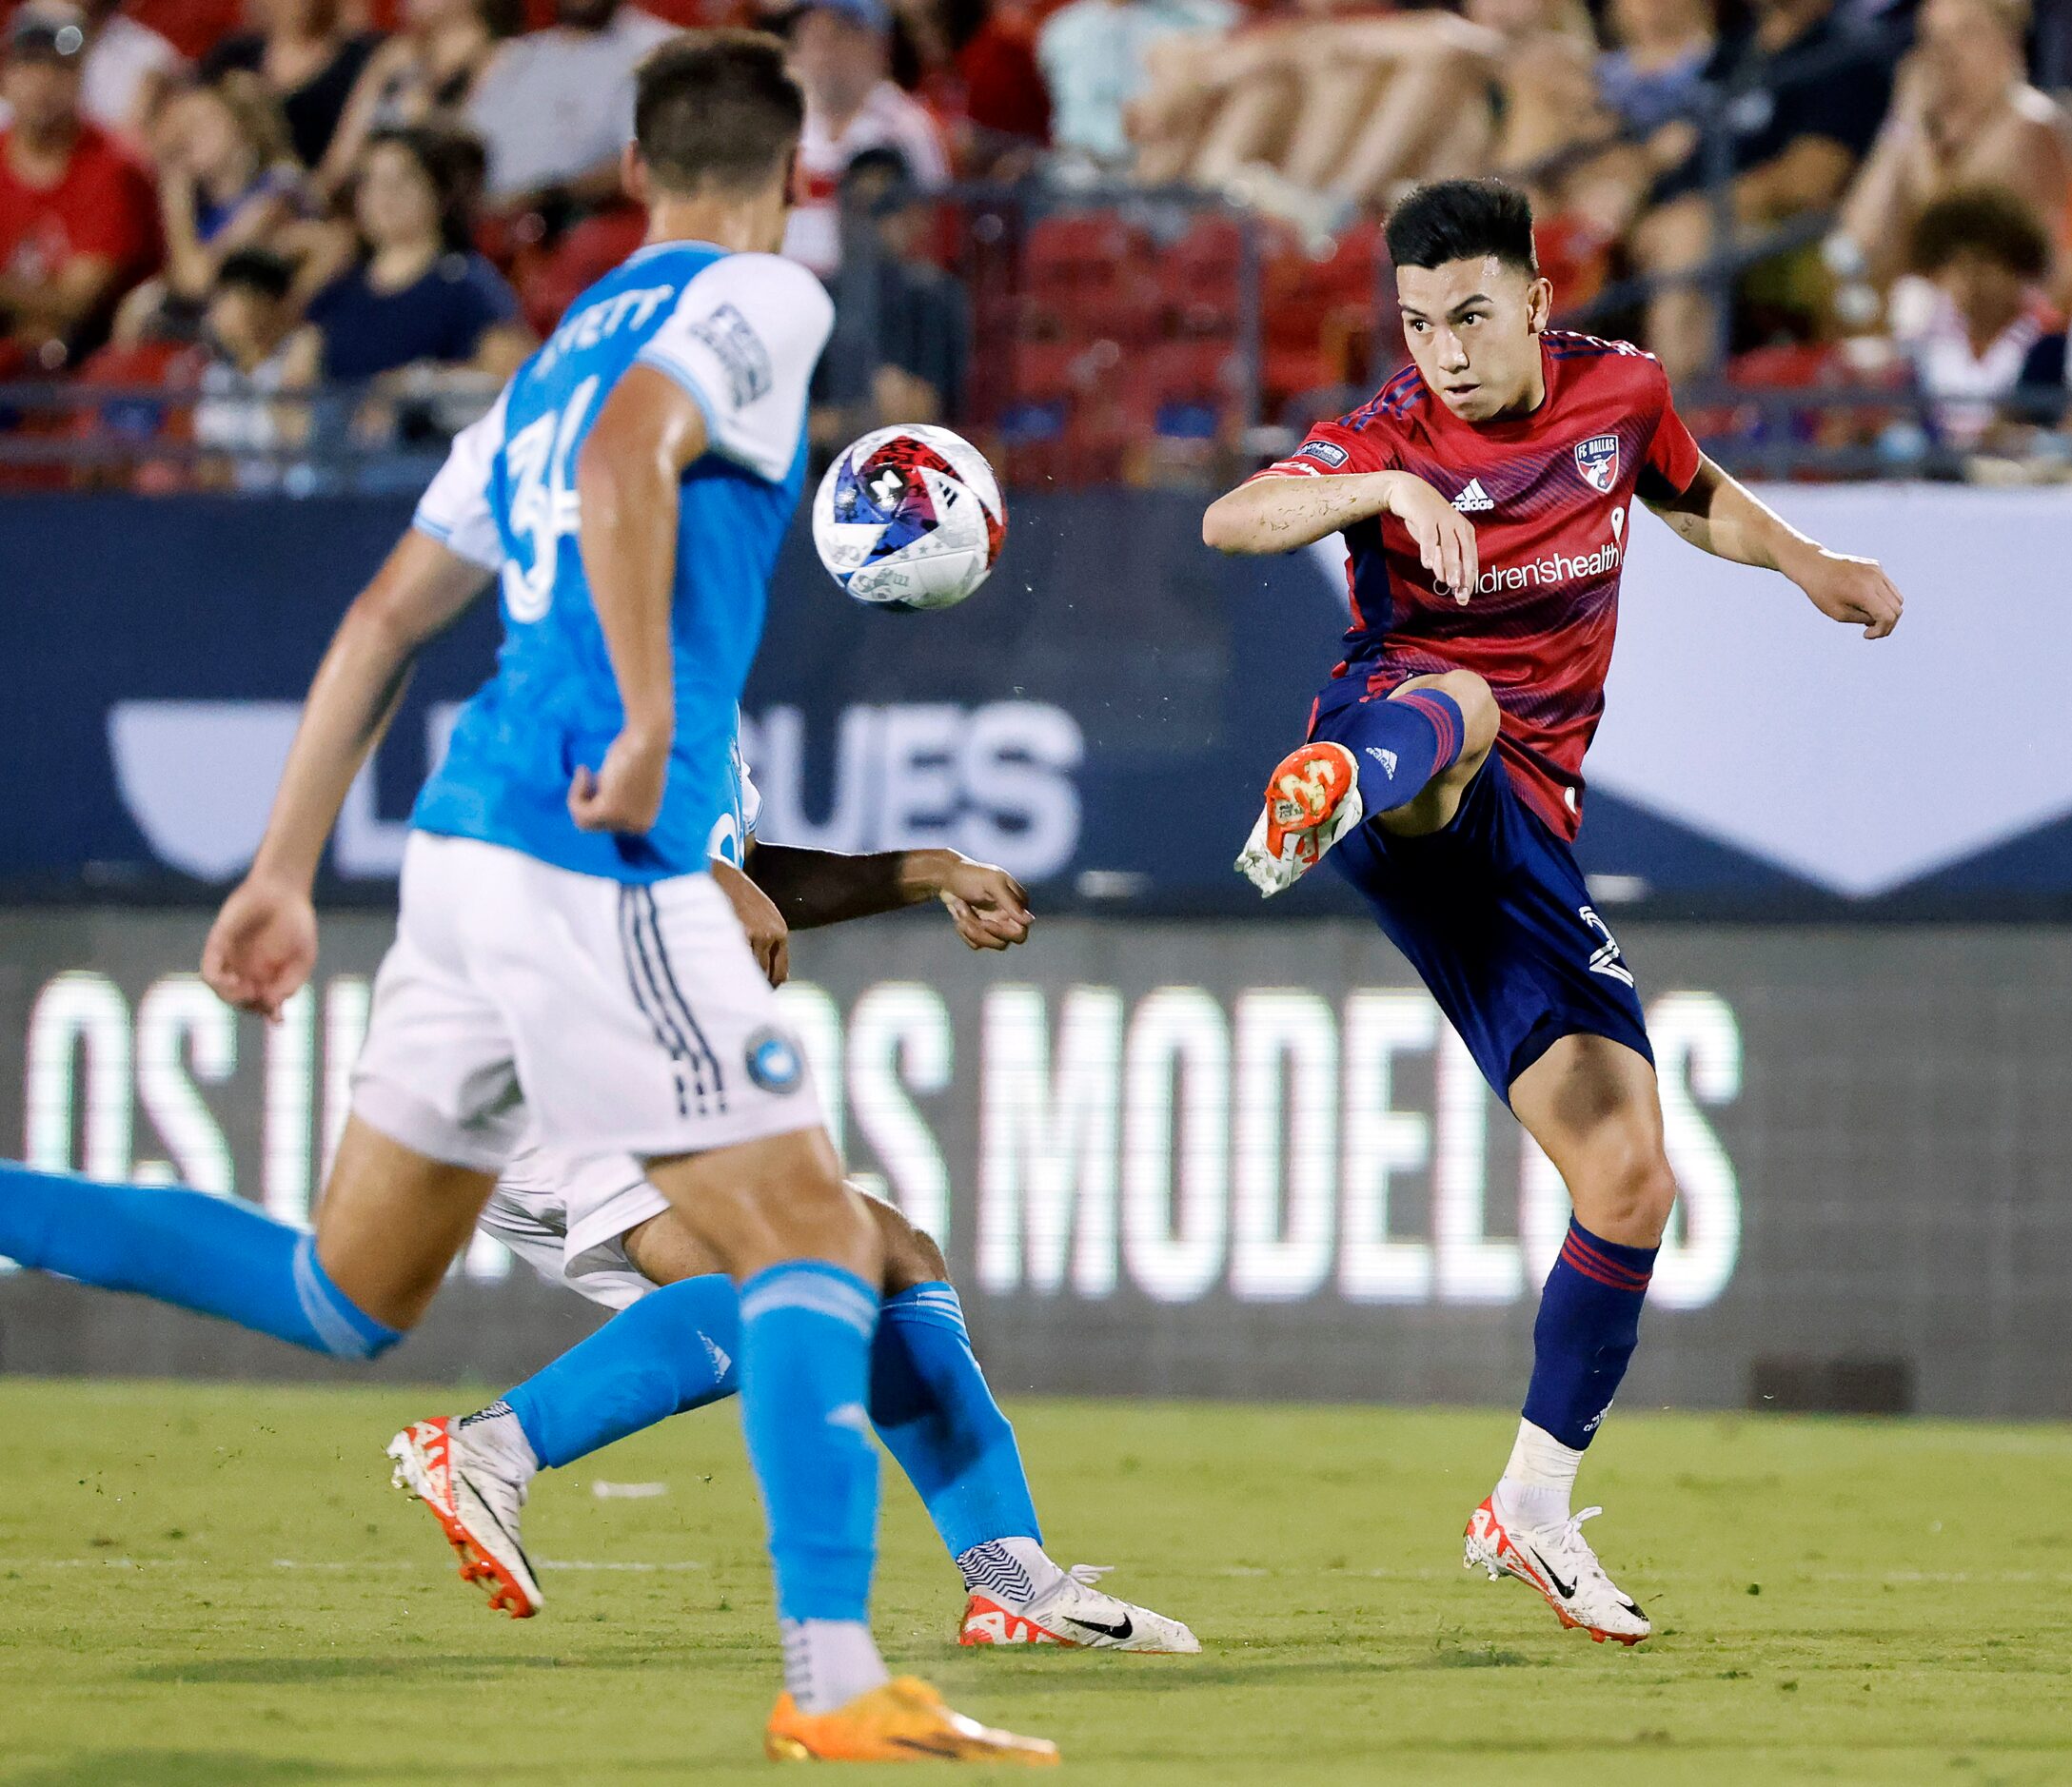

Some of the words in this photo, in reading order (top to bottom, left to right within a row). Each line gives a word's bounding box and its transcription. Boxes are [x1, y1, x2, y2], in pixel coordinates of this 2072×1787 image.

[1578, 444, 1588, 459] FC
[1589, 439, 1615, 455] DALLAS
[1450, 497, 1495, 511] adidas
[1433, 541, 1620, 597] cldren'shealth
[976, 982, 1743, 1309] MODELS
